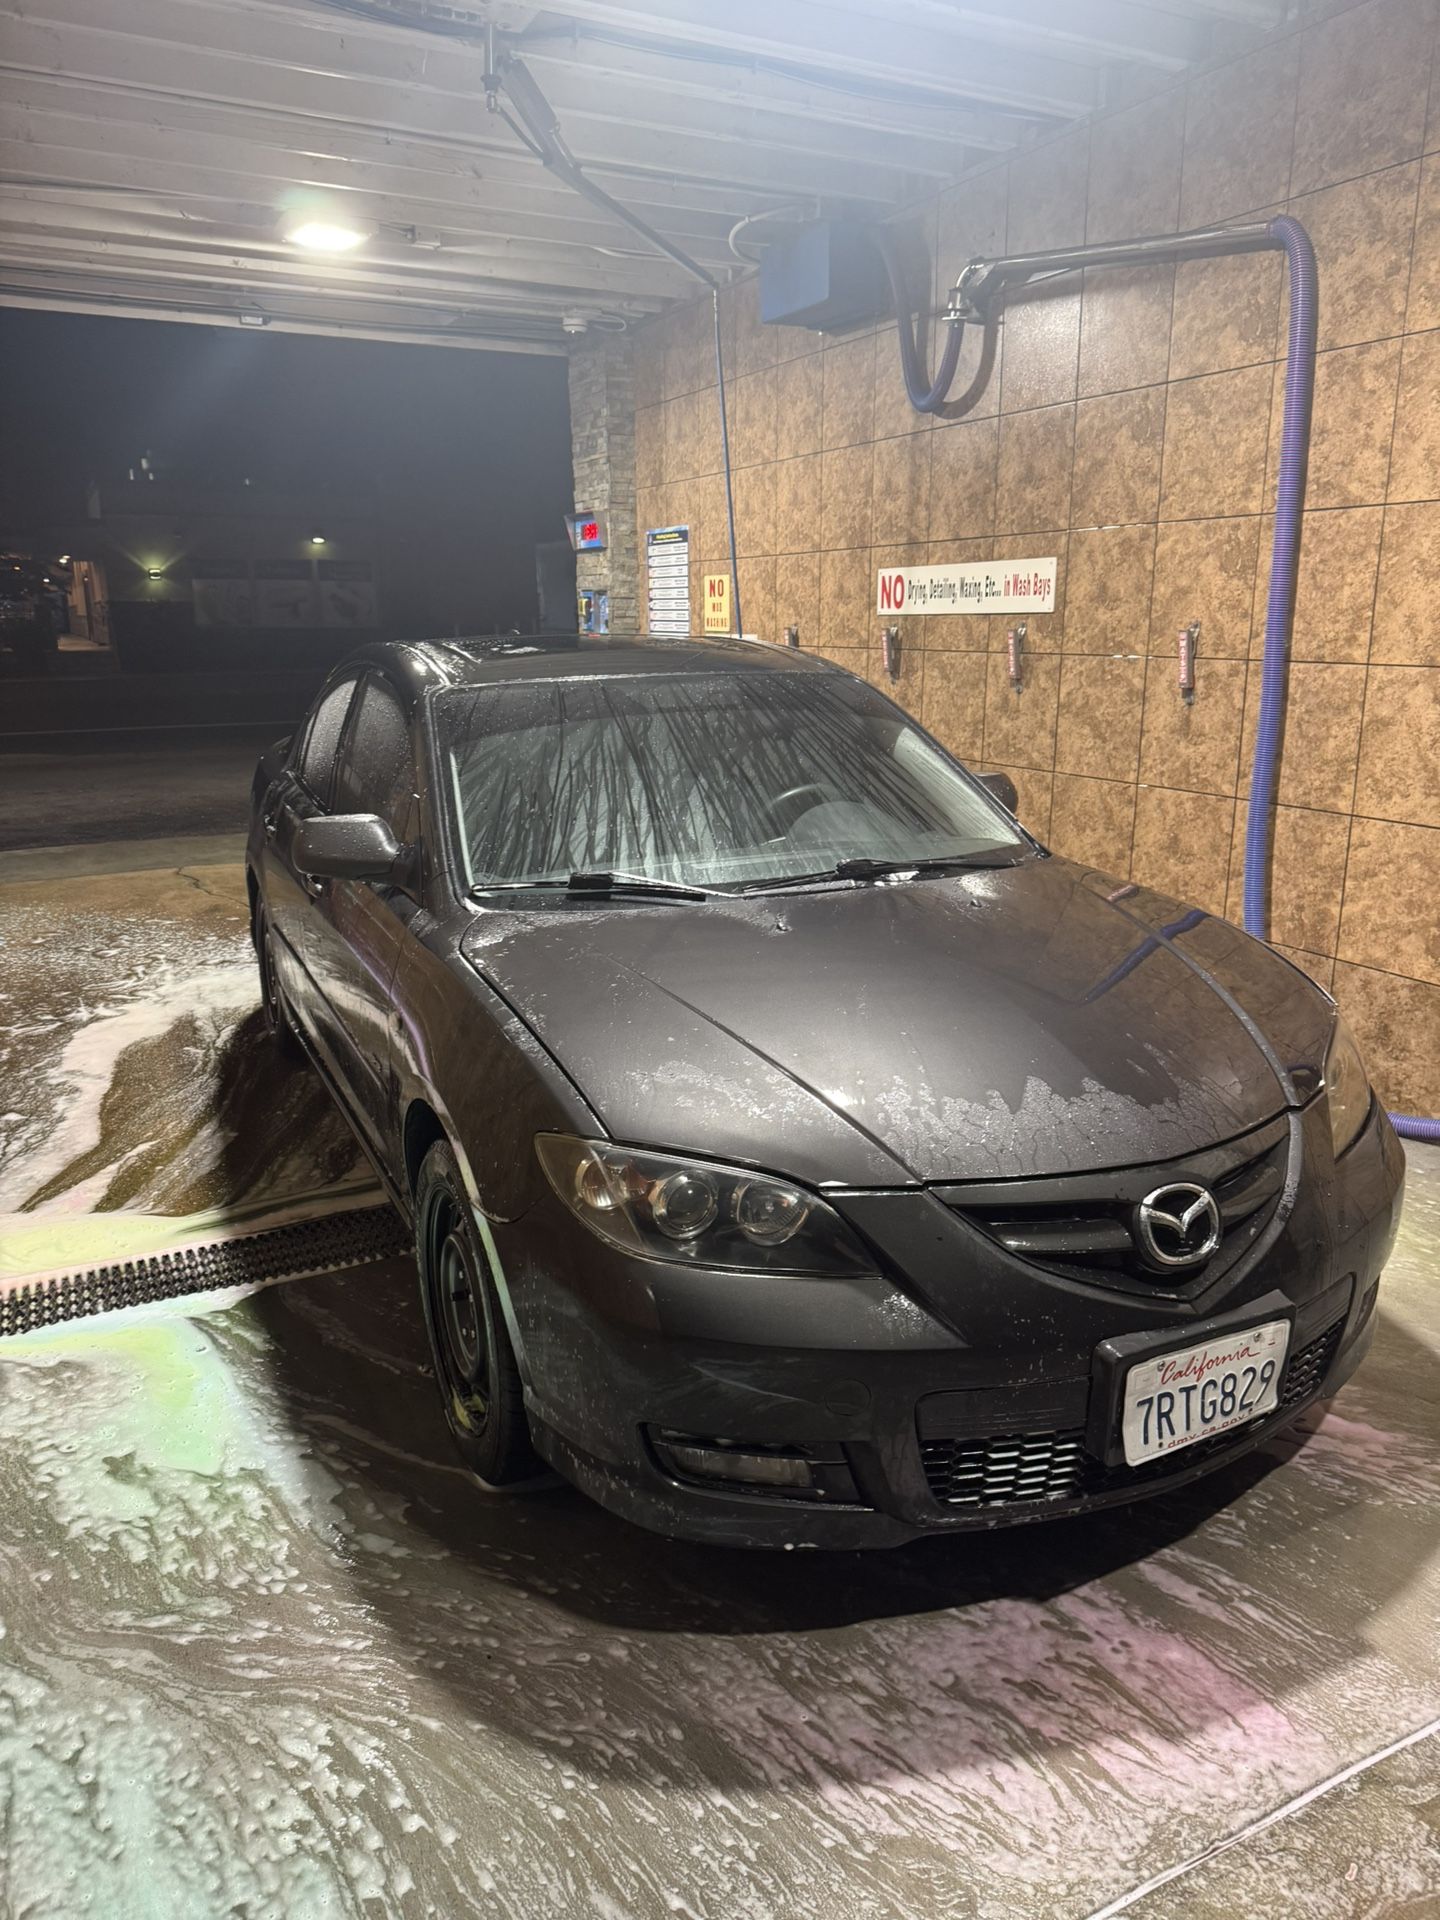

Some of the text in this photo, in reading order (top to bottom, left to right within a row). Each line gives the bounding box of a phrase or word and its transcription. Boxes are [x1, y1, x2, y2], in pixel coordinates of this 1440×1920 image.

[709, 579, 724, 598] NO
[881, 574, 905, 609] NO
[1003, 574, 1010, 597] in
[1012, 573, 1031, 597] Wash
[1033, 573, 1051, 601] Bays
[1160, 1346, 1261, 1385] California
[1136, 1359, 1276, 1446] 7RTG829
